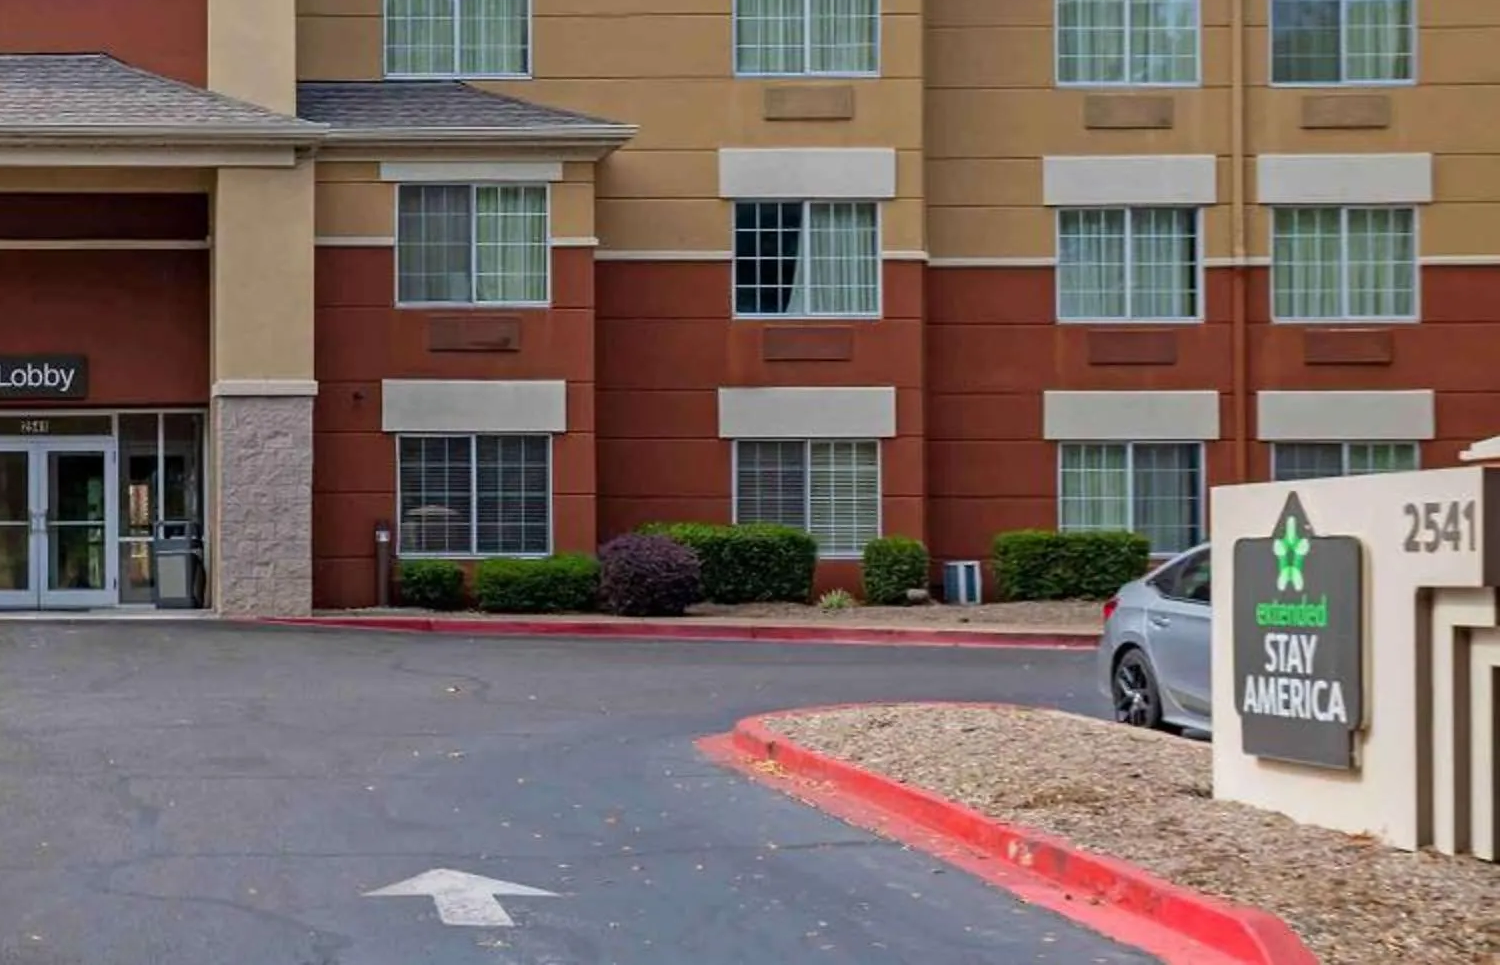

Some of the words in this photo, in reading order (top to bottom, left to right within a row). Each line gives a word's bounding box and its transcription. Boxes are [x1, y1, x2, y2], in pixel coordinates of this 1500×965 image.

[1403, 500, 1476, 553] 2541
[1256, 594, 1328, 627] extended
[1264, 633, 1318, 673] STAY
[1243, 675, 1348, 723] AMERICA
